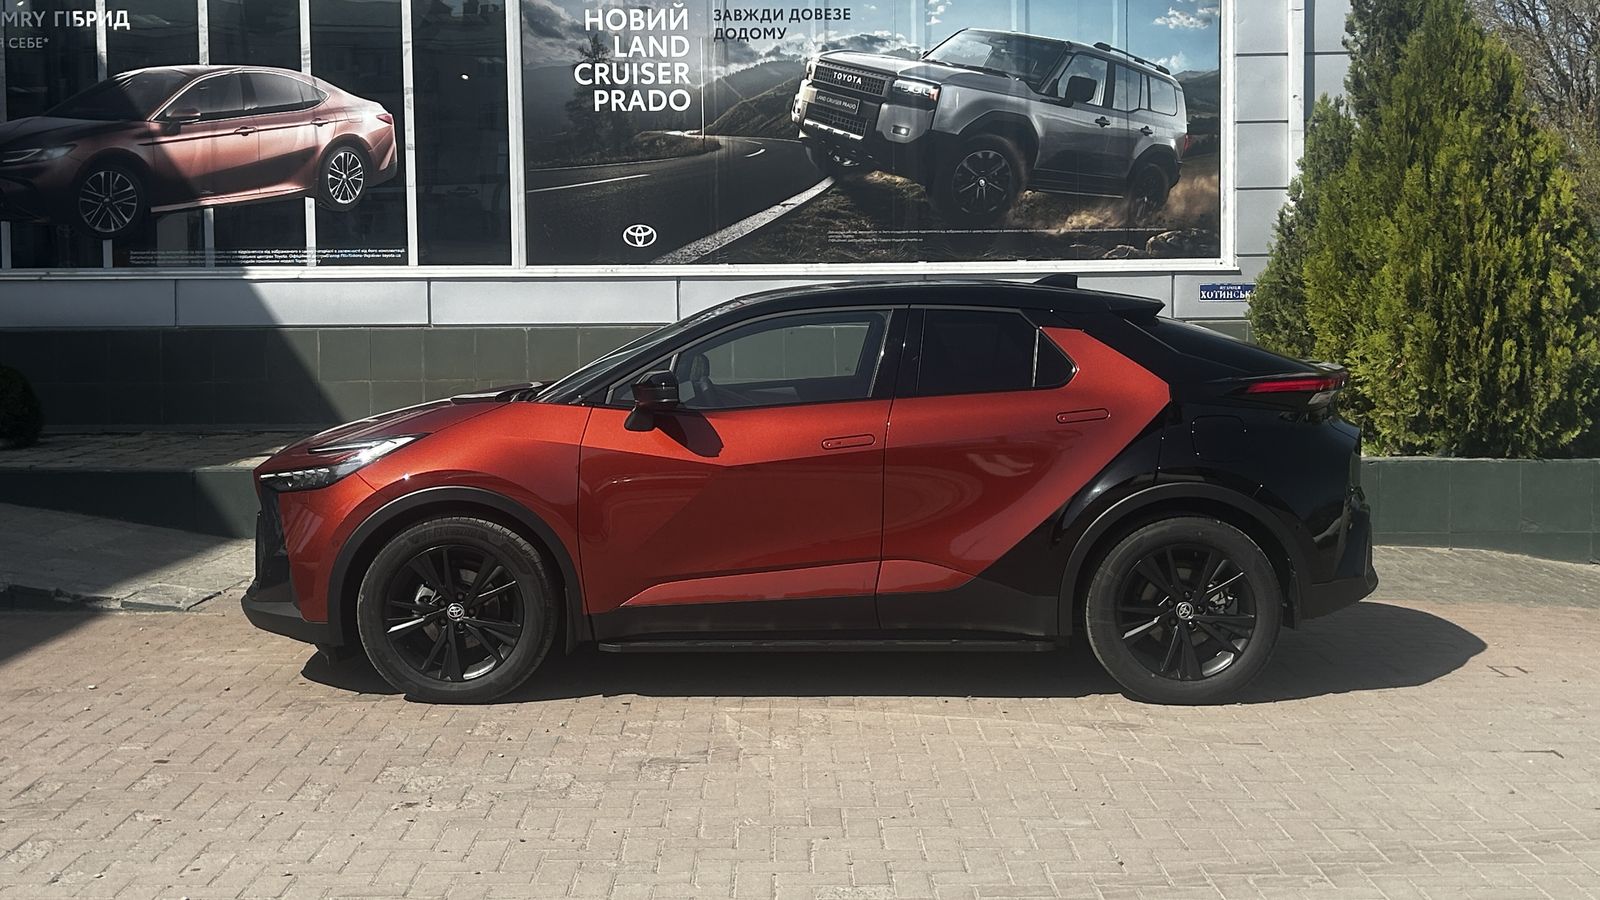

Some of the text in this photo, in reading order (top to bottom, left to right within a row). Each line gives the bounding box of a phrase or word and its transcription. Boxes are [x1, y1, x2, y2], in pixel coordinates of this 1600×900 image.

[54, 10, 131, 30] ГІБРИД
[584, 2, 689, 31] НОВИЙ
[713, 8, 851, 24] ЗАВЖДИ ДОВЕЗЕ
[713, 27, 788, 42] ДОДОМУ
[614, 35, 690, 58] LAND
[574, 62, 691, 85] CRUISER
[833, 71, 862, 85] TOYOTA
[594, 89, 691, 112] PRADO
